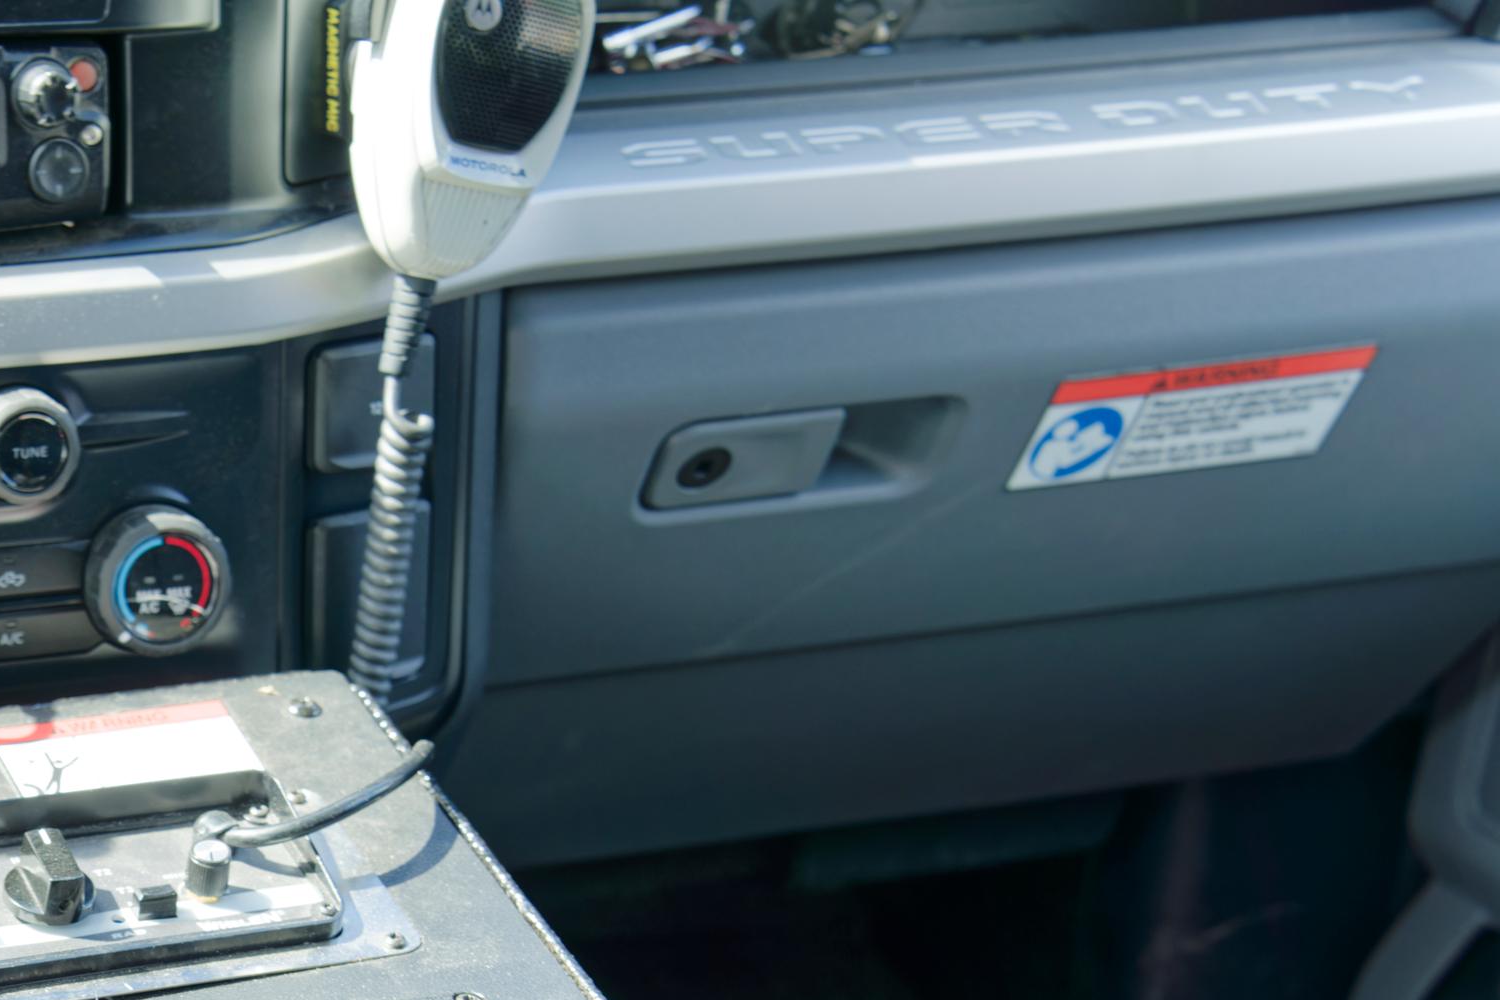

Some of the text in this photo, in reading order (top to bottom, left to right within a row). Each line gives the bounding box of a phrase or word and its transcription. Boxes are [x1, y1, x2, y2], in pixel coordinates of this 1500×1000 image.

[326, 8, 341, 133] MAGNETIC MIC
[619, 74, 1425, 168] SUPER DUTY
[449, 154, 527, 178] MOTOROLA
[11, 445, 50, 460] TUNE
[0, 630, 26, 647] A/C
